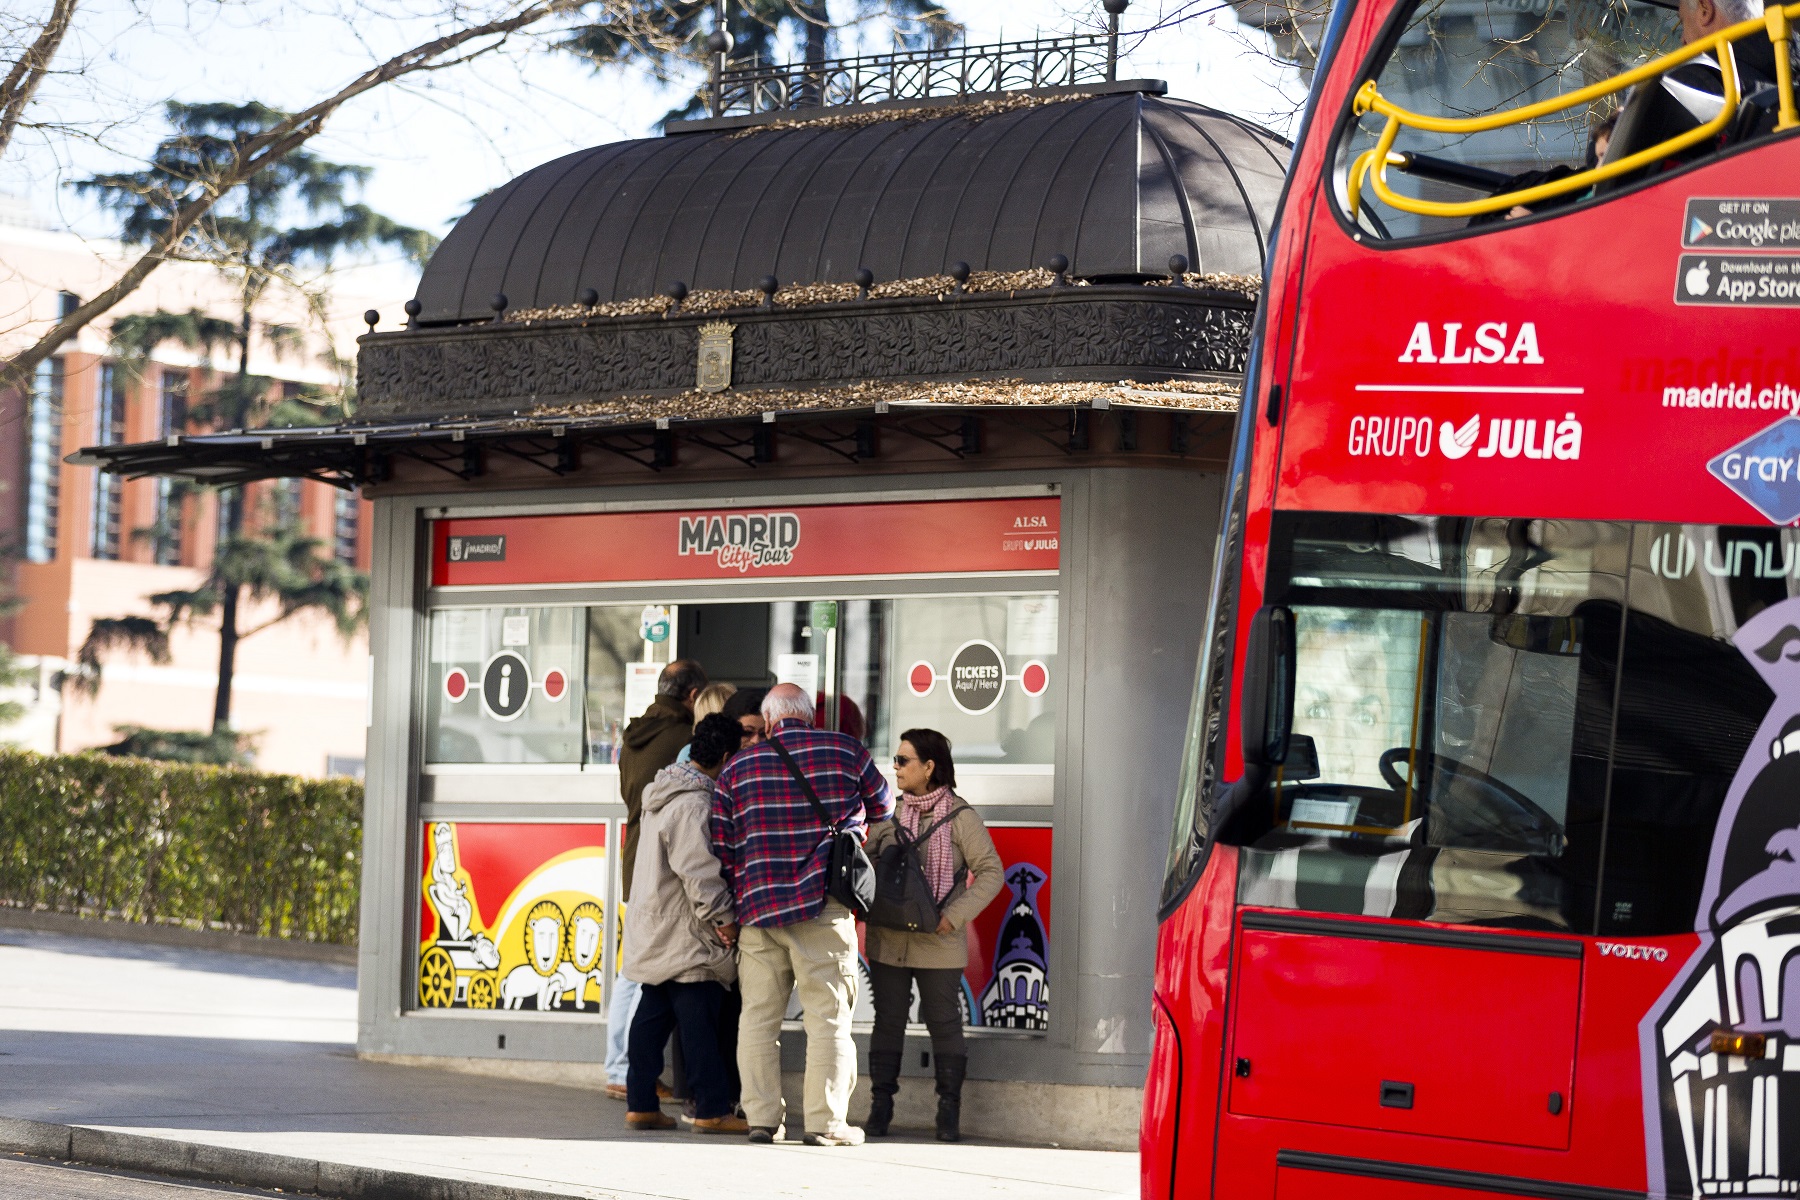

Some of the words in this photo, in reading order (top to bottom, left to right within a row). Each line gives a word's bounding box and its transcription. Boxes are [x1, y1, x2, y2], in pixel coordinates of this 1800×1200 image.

[1719, 202, 1740, 214] GET
[1741, 202, 1752, 214] IT
[1753, 202, 1770, 214] ON
[1716, 217, 1779, 247] Google
[1721, 260, 1773, 275] Download
[1775, 263, 1789, 275] on
[1716, 275, 1756, 302] App
[1398, 322, 1544, 364] ALSA
[1348, 415, 1433, 457] GRUPO
[679, 512, 800, 556] MADRID
[1013, 515, 1048, 528] ALSA
[718, 543, 754, 573] City
[752, 542, 794, 566] Tour
[955, 665, 999, 679] TICKETS
[1595, 941, 1669, 962] VOLVO
